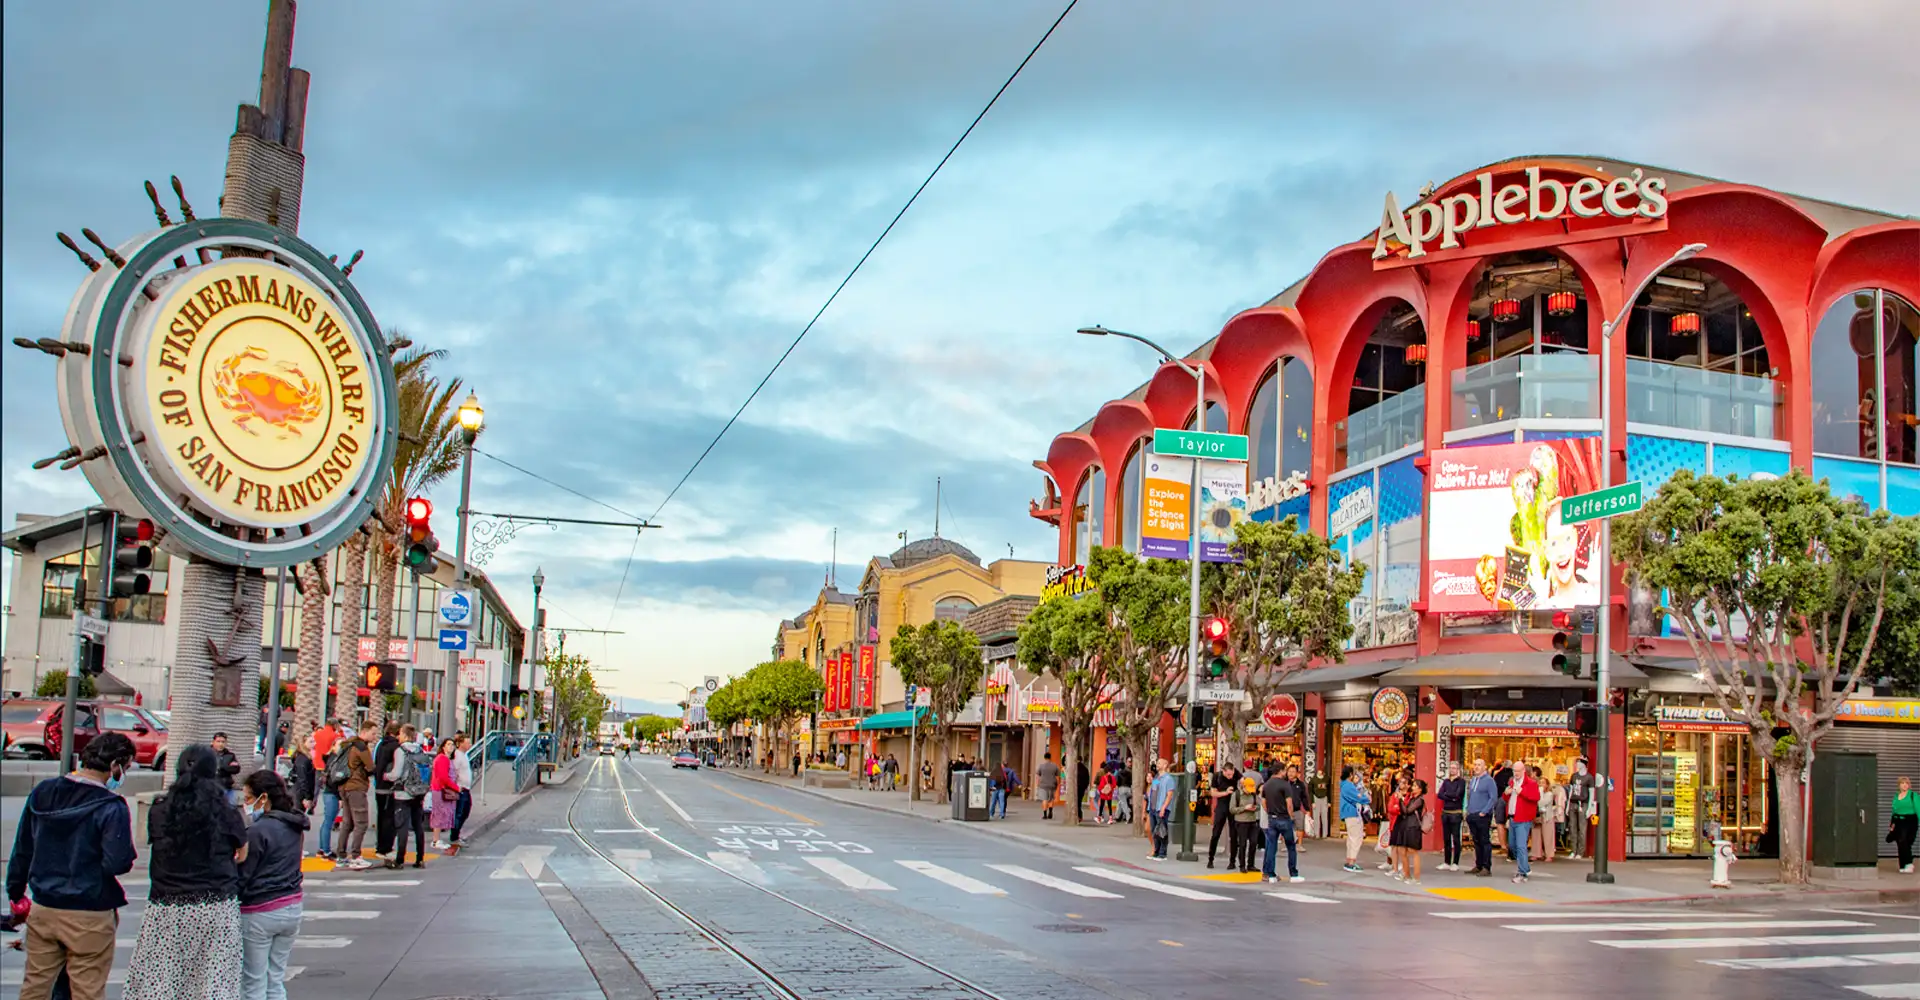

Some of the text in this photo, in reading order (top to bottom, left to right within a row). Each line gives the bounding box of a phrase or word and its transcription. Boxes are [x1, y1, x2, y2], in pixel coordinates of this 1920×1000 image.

[1372, 166, 1668, 259] Applebee's
[159, 275, 364, 424] FISHERMANS WHARF
[159, 389, 359, 513] OF SAN FRANCISCO
[1178, 436, 1226, 453] Taylor
[1211, 480, 1243, 489] Museum
[1434, 473, 1467, 489] Believe
[1148, 488, 1185, 501] Explore
[1224, 488, 1239, 497] Eye
[1148, 499, 1164, 508] the
[1564, 492, 1637, 518] Jefferson
[1148, 508, 1185, 520] Science
[1147, 518, 1185, 531] of Sight
[1209, 691, 1235, 700] Taylor
[1664, 707, 1705, 718] WHARF
[1855, 702, 1896, 717] Shades
[1898, 704, 1910, 717] of
[1460, 712, 1568, 724] WHARF CENTRA
[1305, 731, 1317, 784] BILLABONG
[718, 825, 826, 838] KEEP
[712, 836, 874, 854] CLEAR
